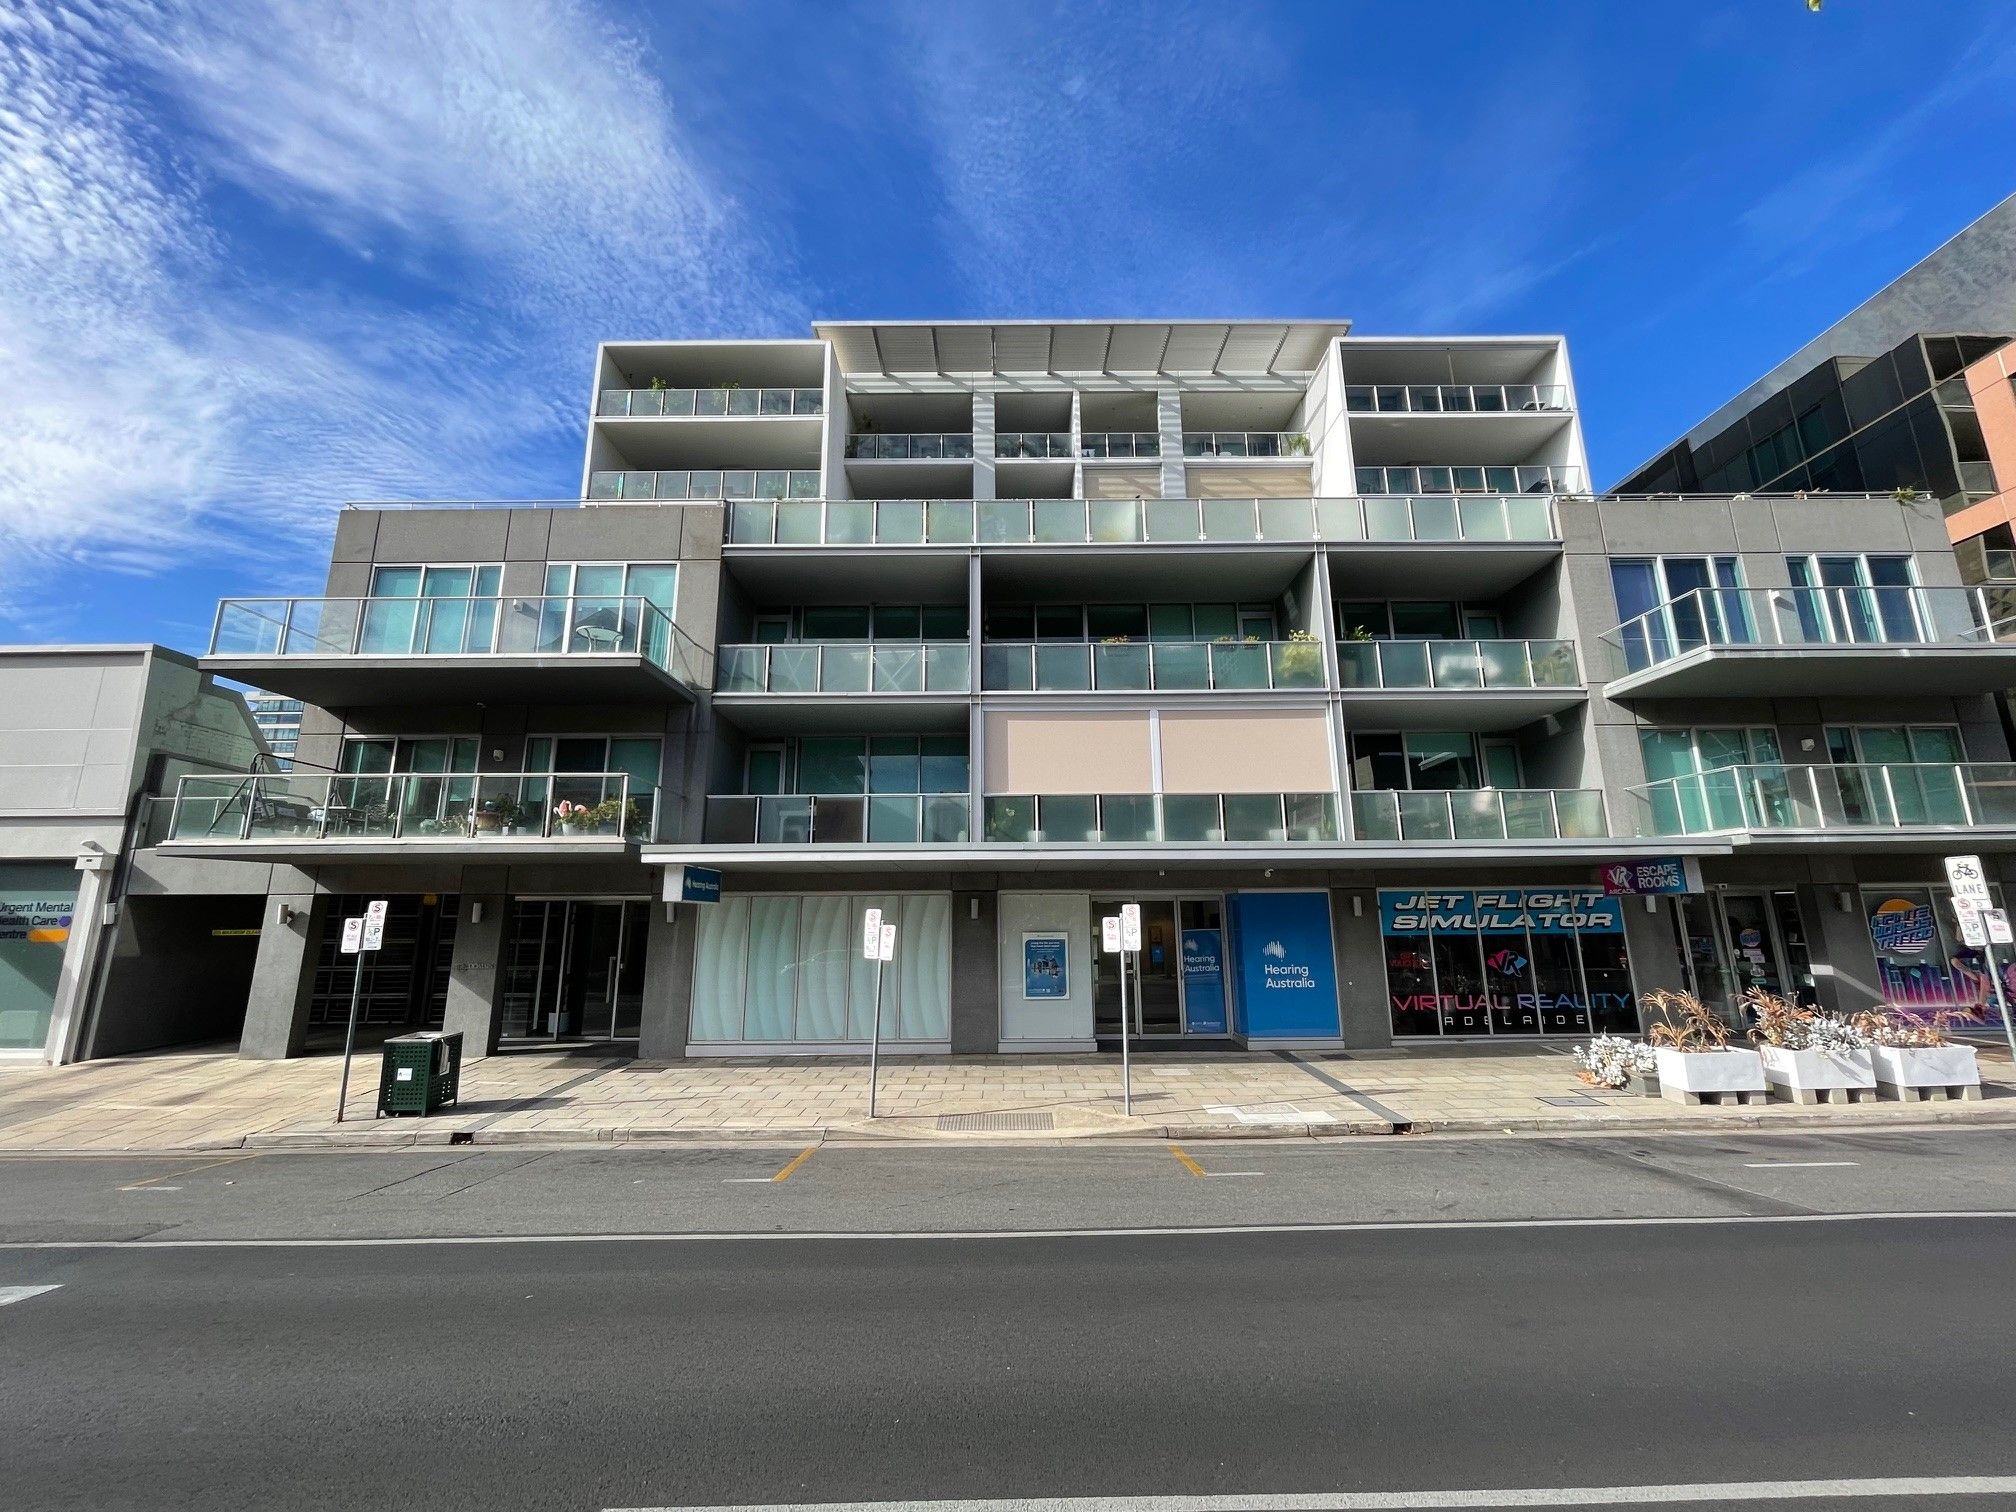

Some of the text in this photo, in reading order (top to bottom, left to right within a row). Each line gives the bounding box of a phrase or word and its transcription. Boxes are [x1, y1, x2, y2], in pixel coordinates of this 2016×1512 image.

[1636, 863, 1678, 877] ESCAPE
[1638, 875, 1680, 889] ROOMS
[1608, 887, 1637, 895] ARCADE
[1955, 883, 1984, 895] LANE
[35, 902, 74, 912] Mental
[1395, 893, 1604, 909] JET FLIGHT
[0, 915, 58, 926] ealth Care
[1393, 913, 1613, 929] SIMULATOR
[0, 929, 27, 939] entre
[1184, 955, 1216, 964] Hearing
[1185, 963, 1220, 972] Australia
[1264, 964, 1309, 977] Hearing
[1265, 977, 1316, 989] Australia
[1392, 993, 1630, 1011] VIRTUAL REALITY
[1444, 1014, 1585, 1026] ADELAIDE
